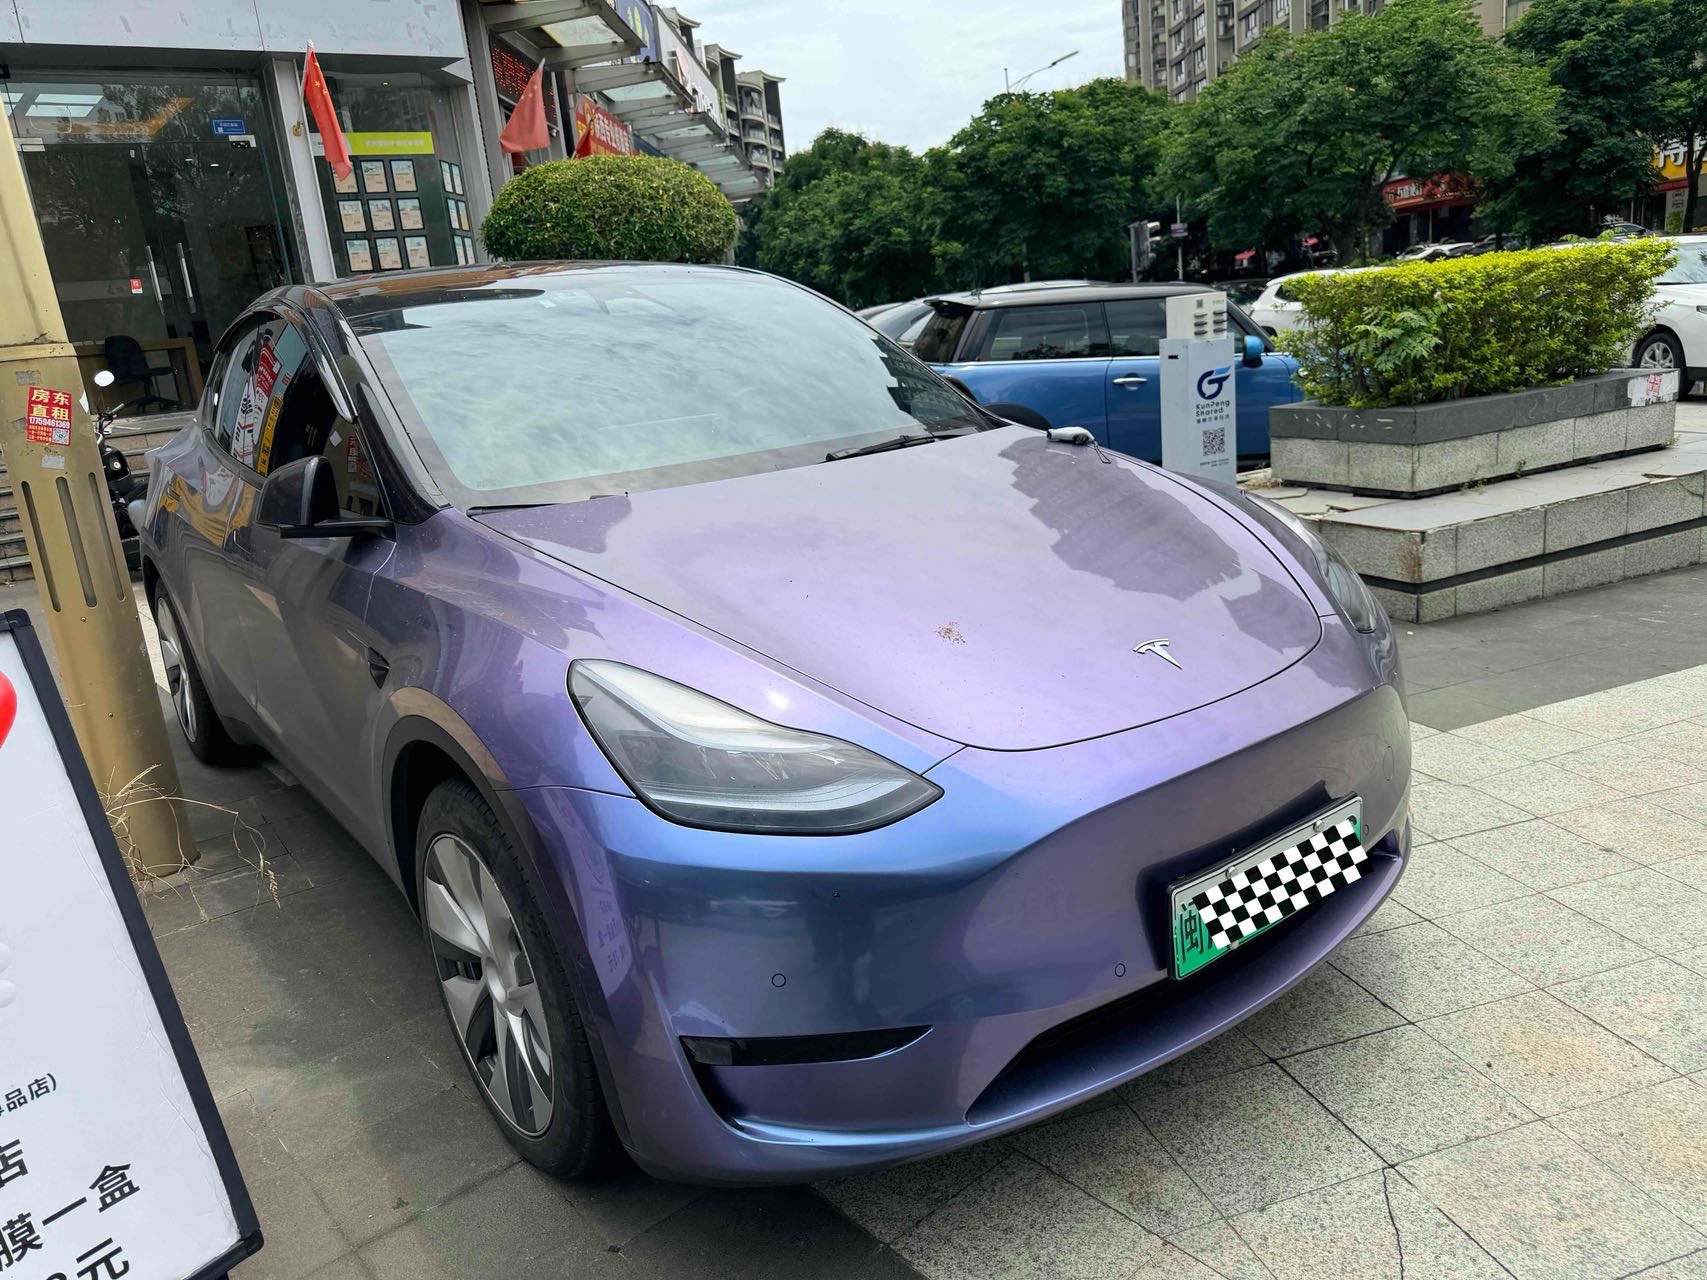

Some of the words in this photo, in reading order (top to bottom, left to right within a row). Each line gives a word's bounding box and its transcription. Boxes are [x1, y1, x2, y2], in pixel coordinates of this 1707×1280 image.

[31, 389, 70, 405] 房东
[1195, 400, 1231, 410] KunPeng
[29, 404, 70, 421] 直租
[1195, 407, 1224, 418] Shared
[1180, 902, 1212, 963] 闽
[0, 1073, 57, 1116] 品店)
[0, 1164, 140, 1272] 膜一盒
[45, 1237, 130, 1280] 元
